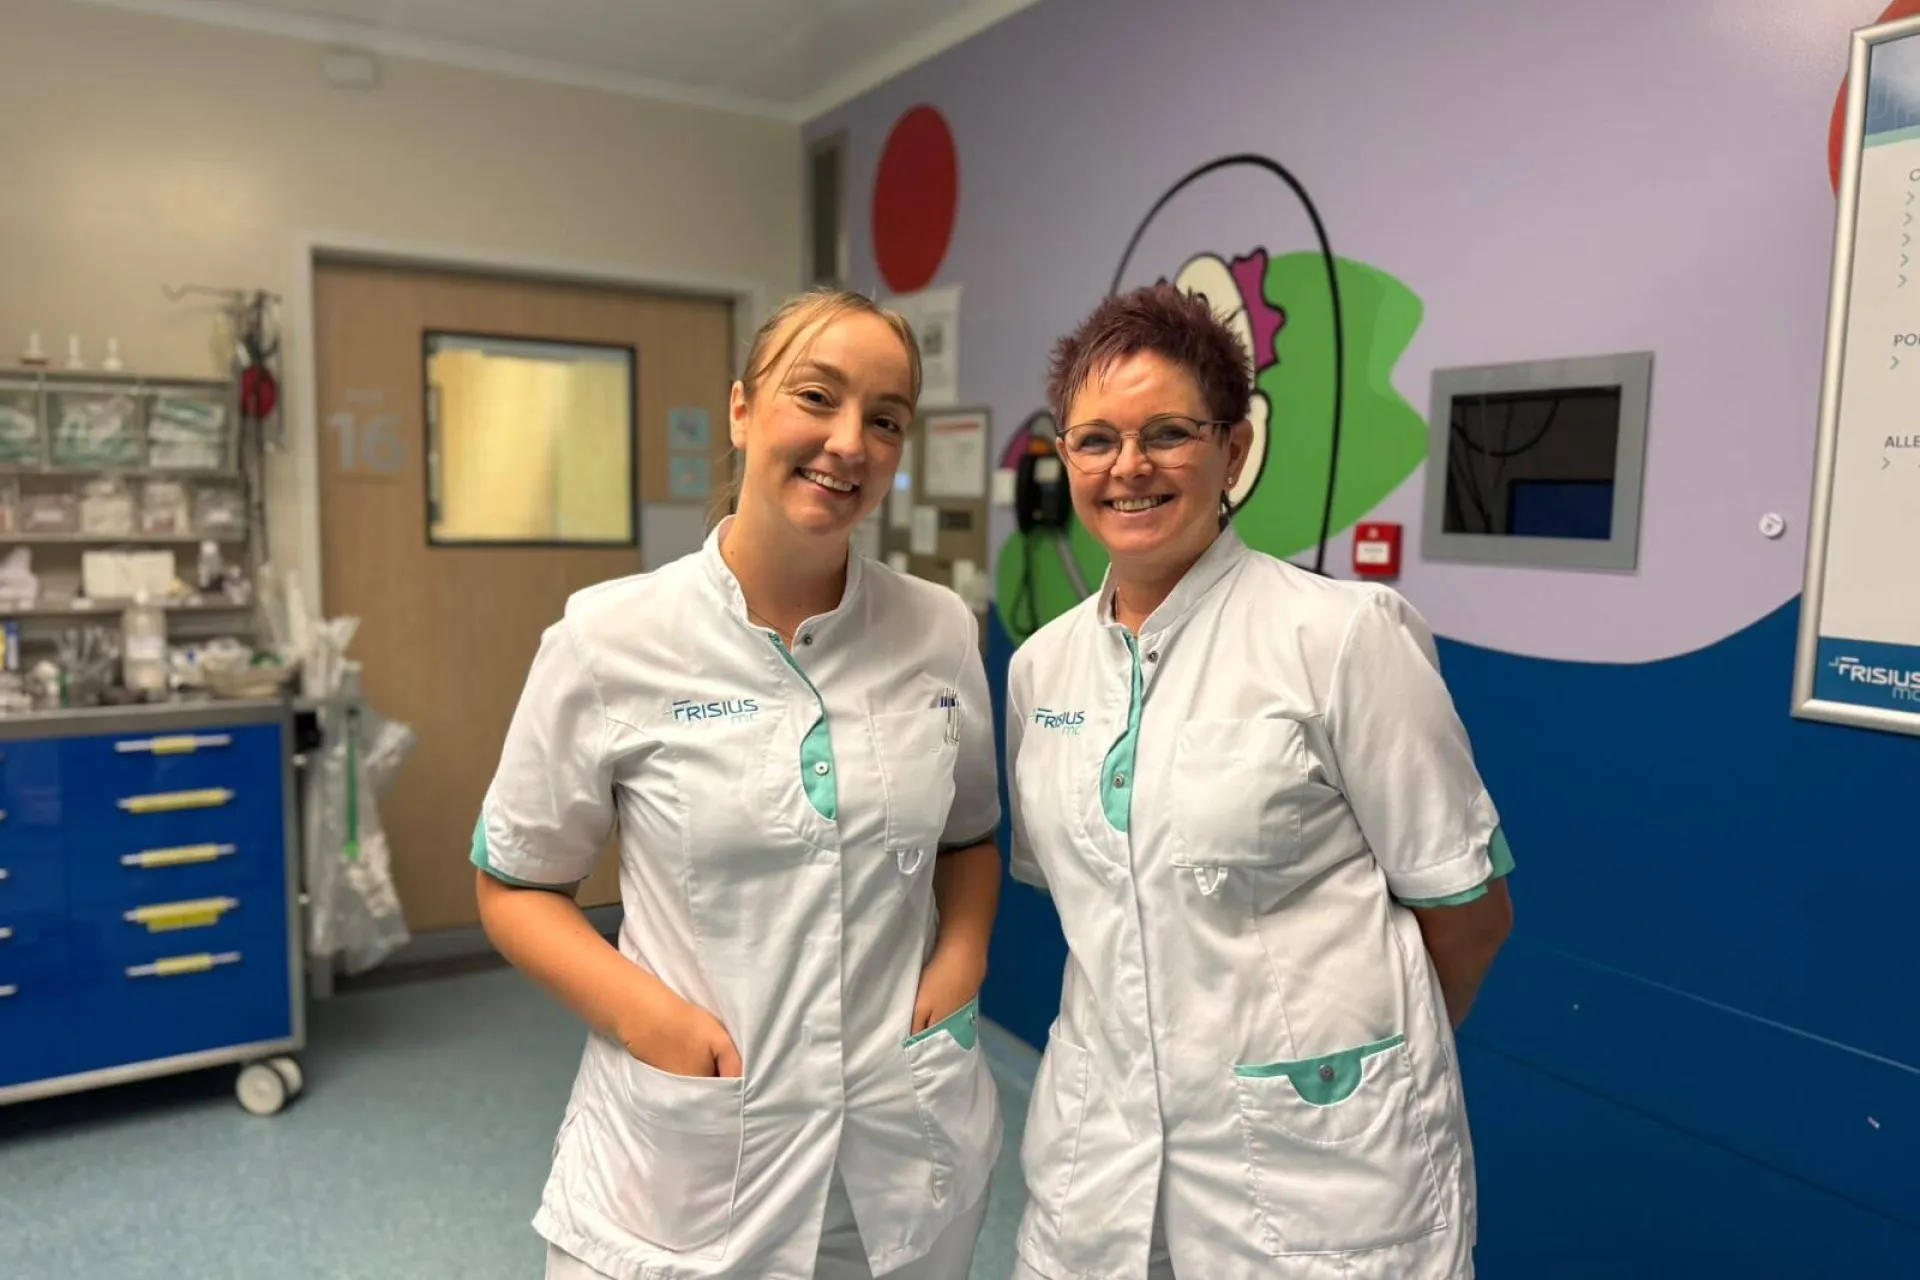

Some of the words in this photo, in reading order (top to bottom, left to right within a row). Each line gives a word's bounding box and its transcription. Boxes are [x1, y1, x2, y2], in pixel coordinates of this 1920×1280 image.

[325, 411, 406, 473] 16
[1884, 435, 1920, 449] ALLE
[1838, 656, 1920, 689] FRISIUS
[672, 699, 759, 721] FRISIUS
